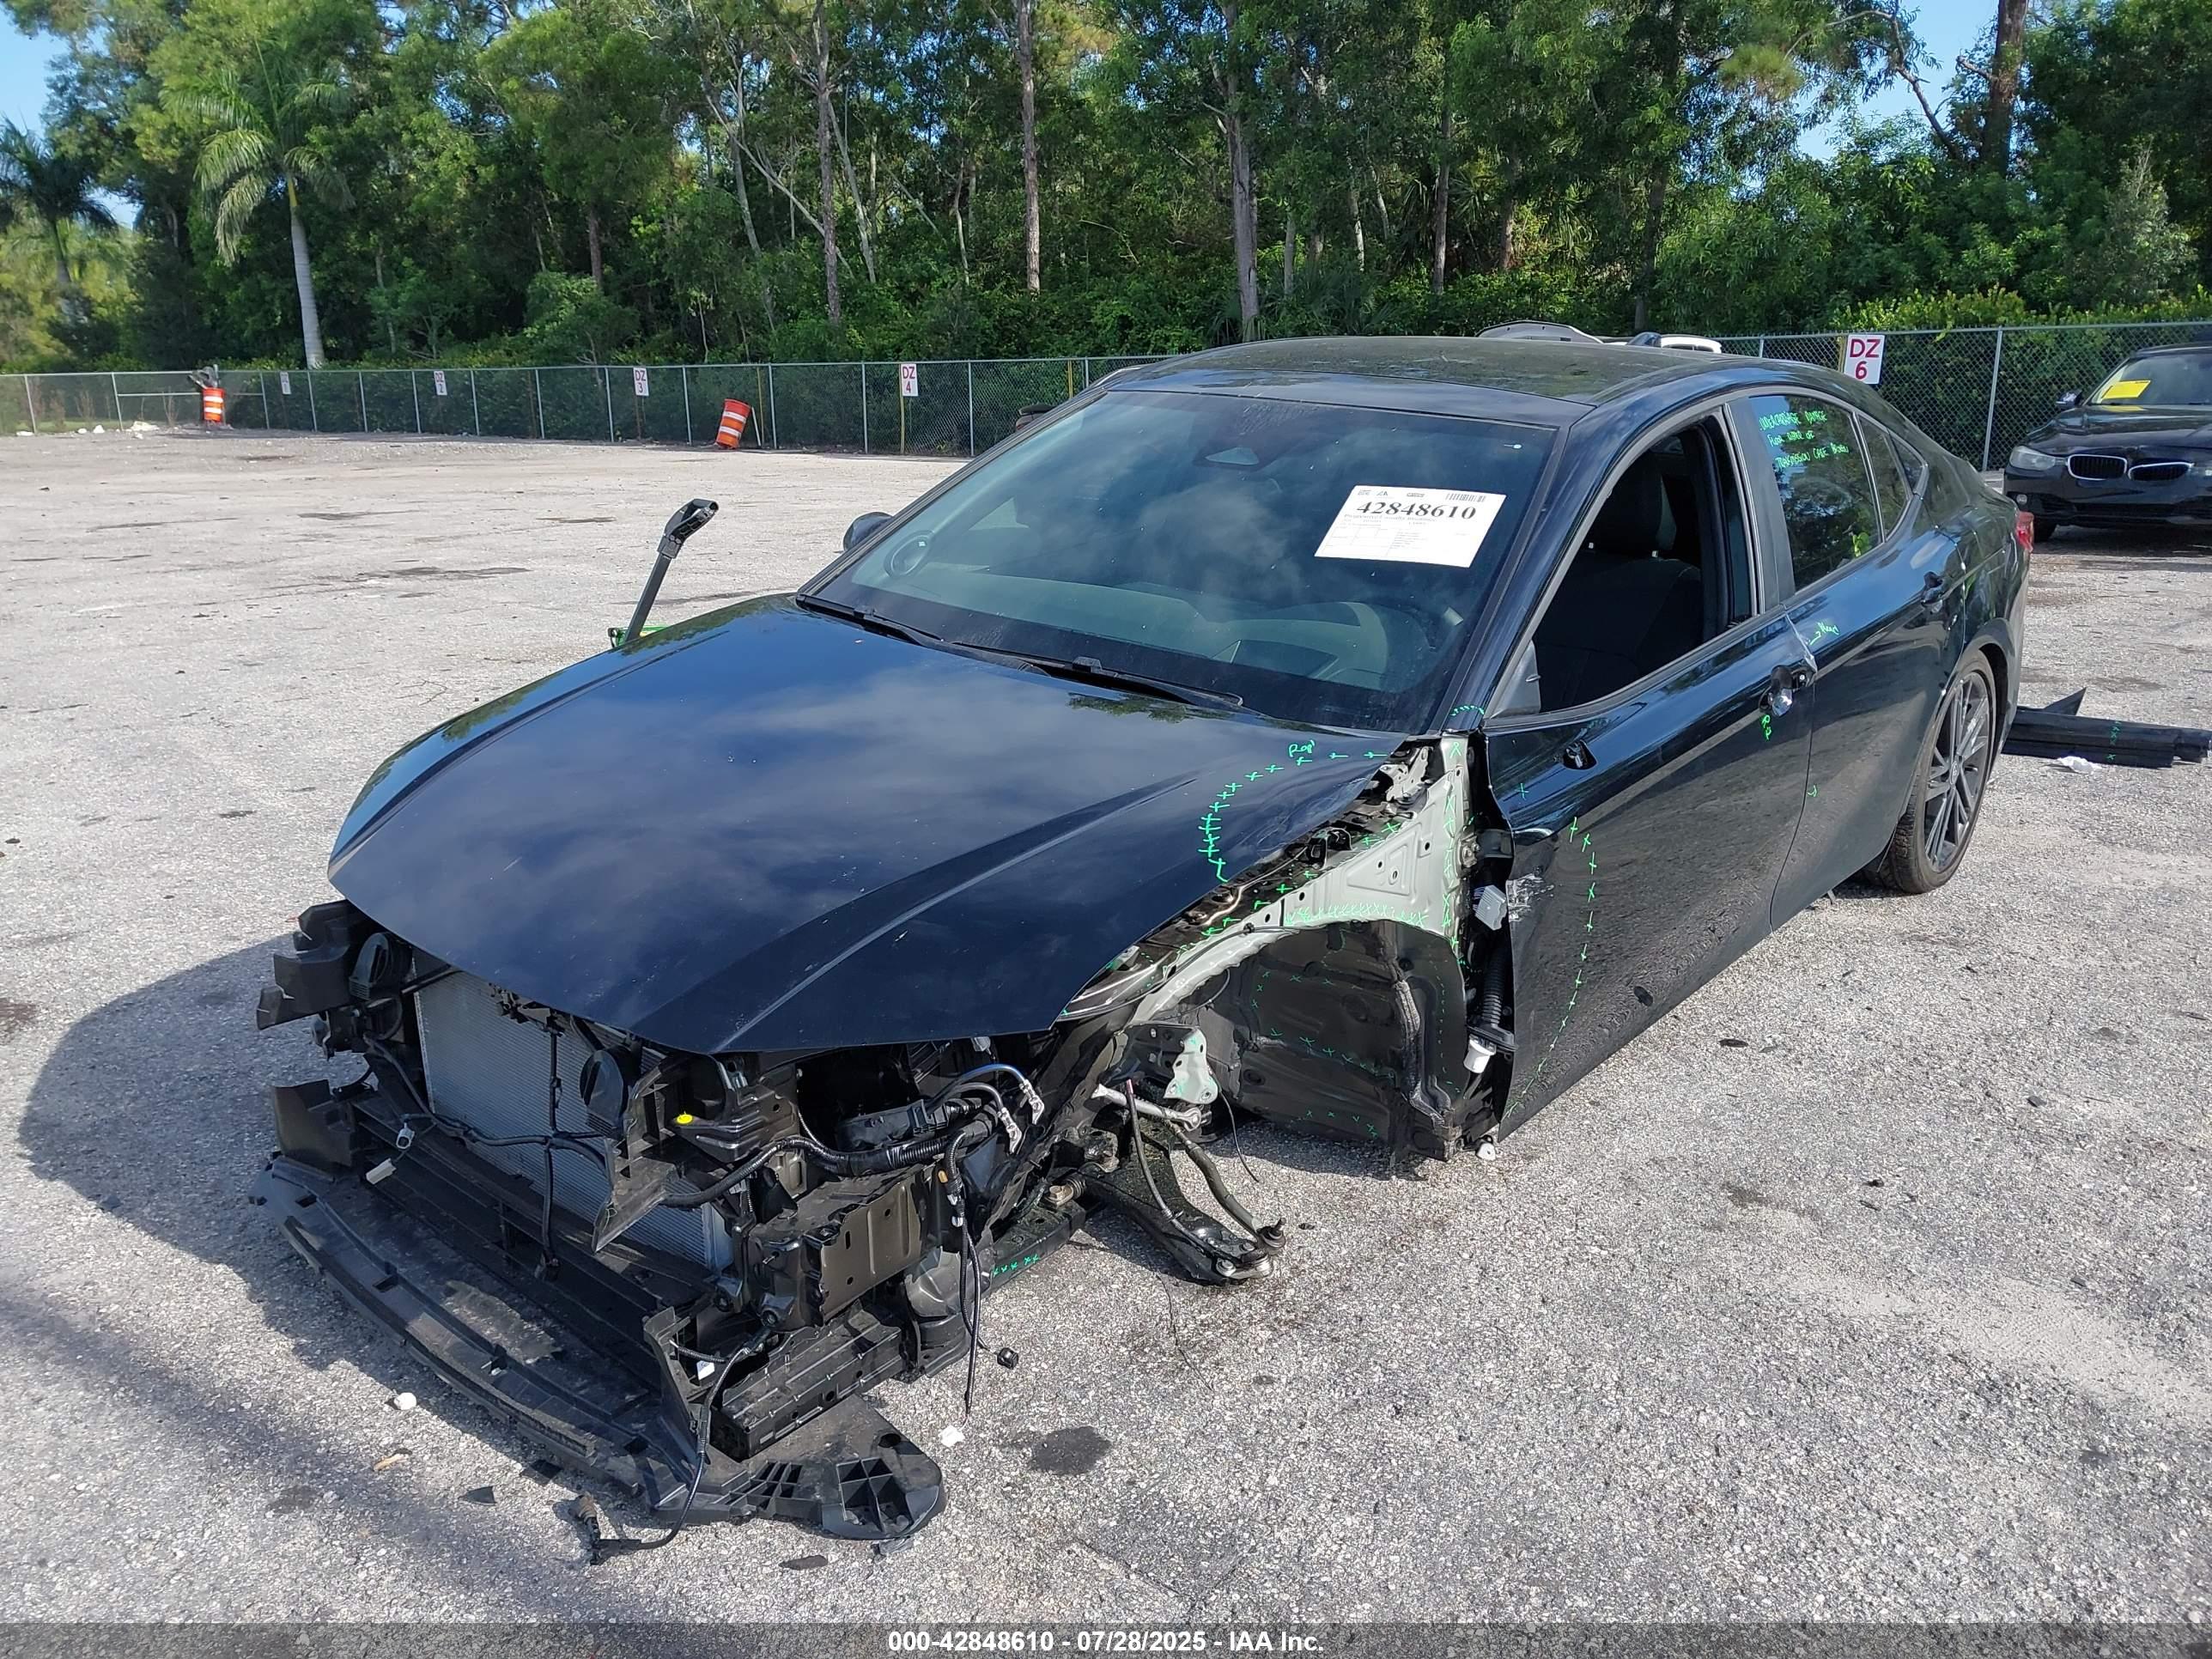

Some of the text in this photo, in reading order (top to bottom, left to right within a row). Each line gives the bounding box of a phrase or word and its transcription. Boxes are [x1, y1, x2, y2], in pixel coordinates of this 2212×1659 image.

[1850, 338, 1881, 357] DZ
[635, 370, 646, 381] DZ
[902, 366, 915, 379] DZ
[1856, 361, 1867, 380] 6
[637, 382, 643, 393] 3
[906, 381, 911, 393] 4
[1356, 501, 1476, 520] 42848610
